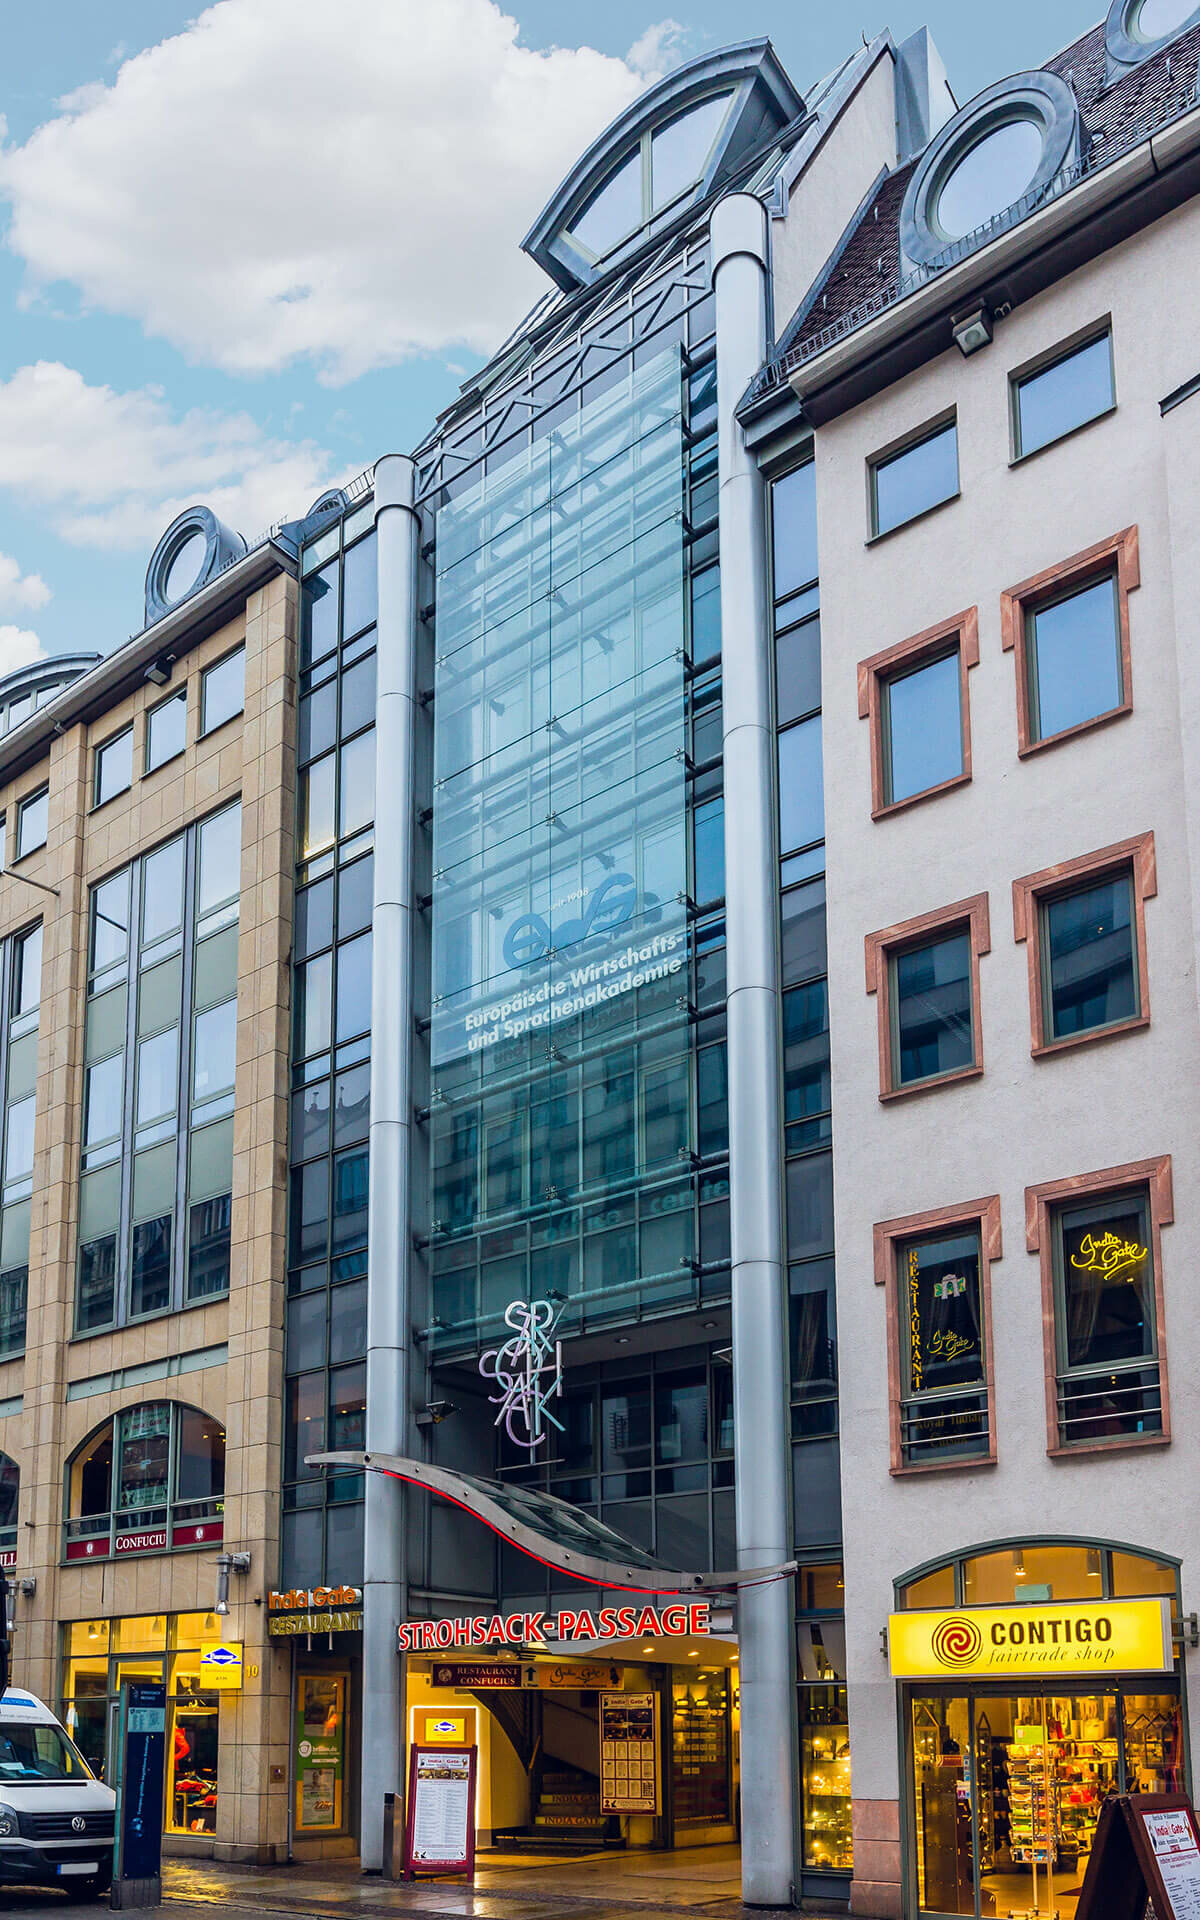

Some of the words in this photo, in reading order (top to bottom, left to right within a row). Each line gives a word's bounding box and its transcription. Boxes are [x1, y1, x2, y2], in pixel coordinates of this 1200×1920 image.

[465, 979, 567, 1032] Europäische
[570, 934, 684, 988] Wirtschafts-
[468, 1024, 499, 1051] und
[503, 957, 682, 1040] Sprachenakademie
[1071, 1232, 1121, 1267] India
[1093, 1241, 1147, 1274] Gate
[269, 1589, 308, 1609] India
[313, 1585, 357, 1607] Gate
[269, 1611, 361, 1636] RESTAURANT
[399, 1603, 710, 1651] STROHSACK-PASSAGE
[991, 1617, 1112, 1645] CONTIGO
[986, 1646, 1067, 1667] fairtrade
[1074, 1645, 1115, 1663] shop
[247, 1664, 258, 1678] 10
[457, 1666, 519, 1676] RESTAURANT
[460, 1677, 516, 1686] CONFUCIUS
[545, 1815, 573, 1825] INDIA
